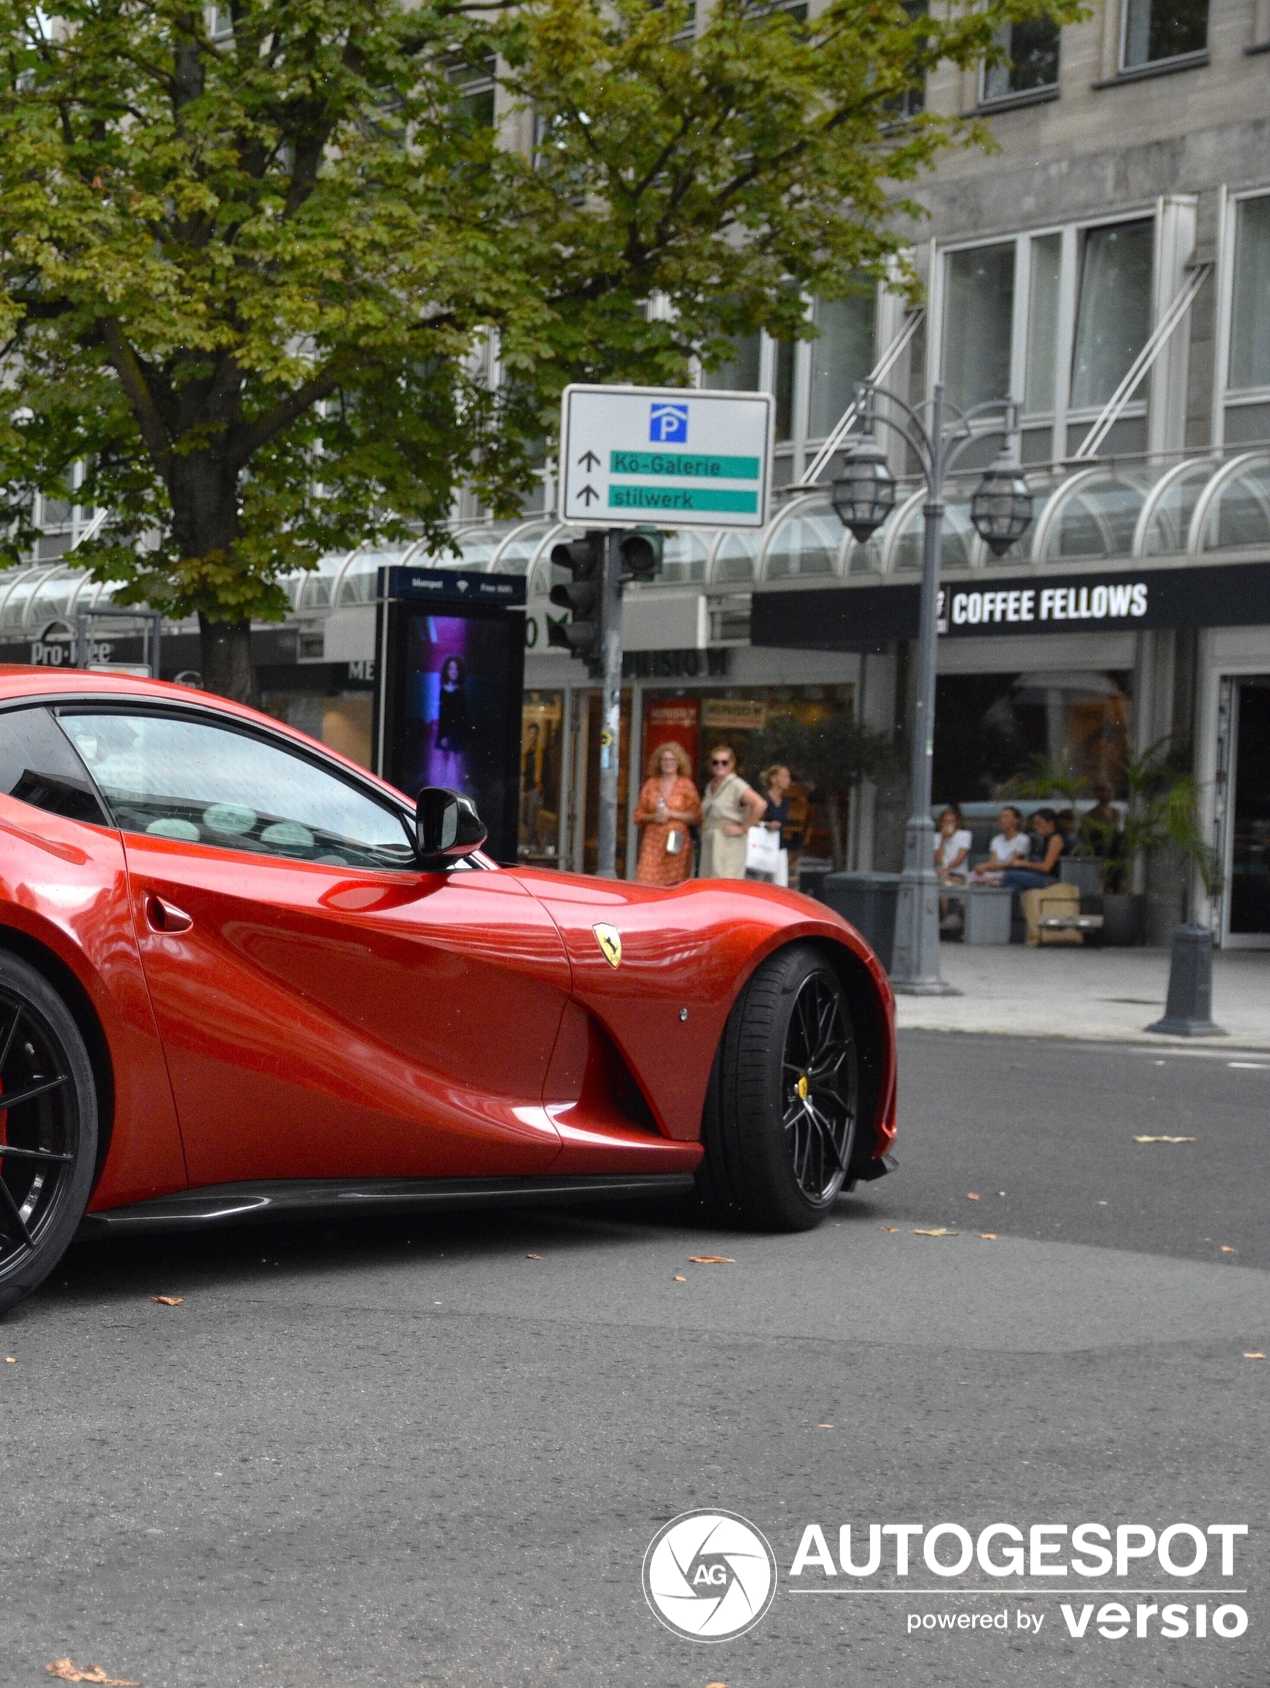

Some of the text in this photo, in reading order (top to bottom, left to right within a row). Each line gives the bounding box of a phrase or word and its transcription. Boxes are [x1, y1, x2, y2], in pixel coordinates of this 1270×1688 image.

[660, 416, 680, 441] P
[614, 453, 722, 476] Kö-Galerie
[614, 489, 694, 508] stilwerk
[952, 589, 1035, 625] COFFEE
[1039, 583, 1148, 621] FELLOWS
